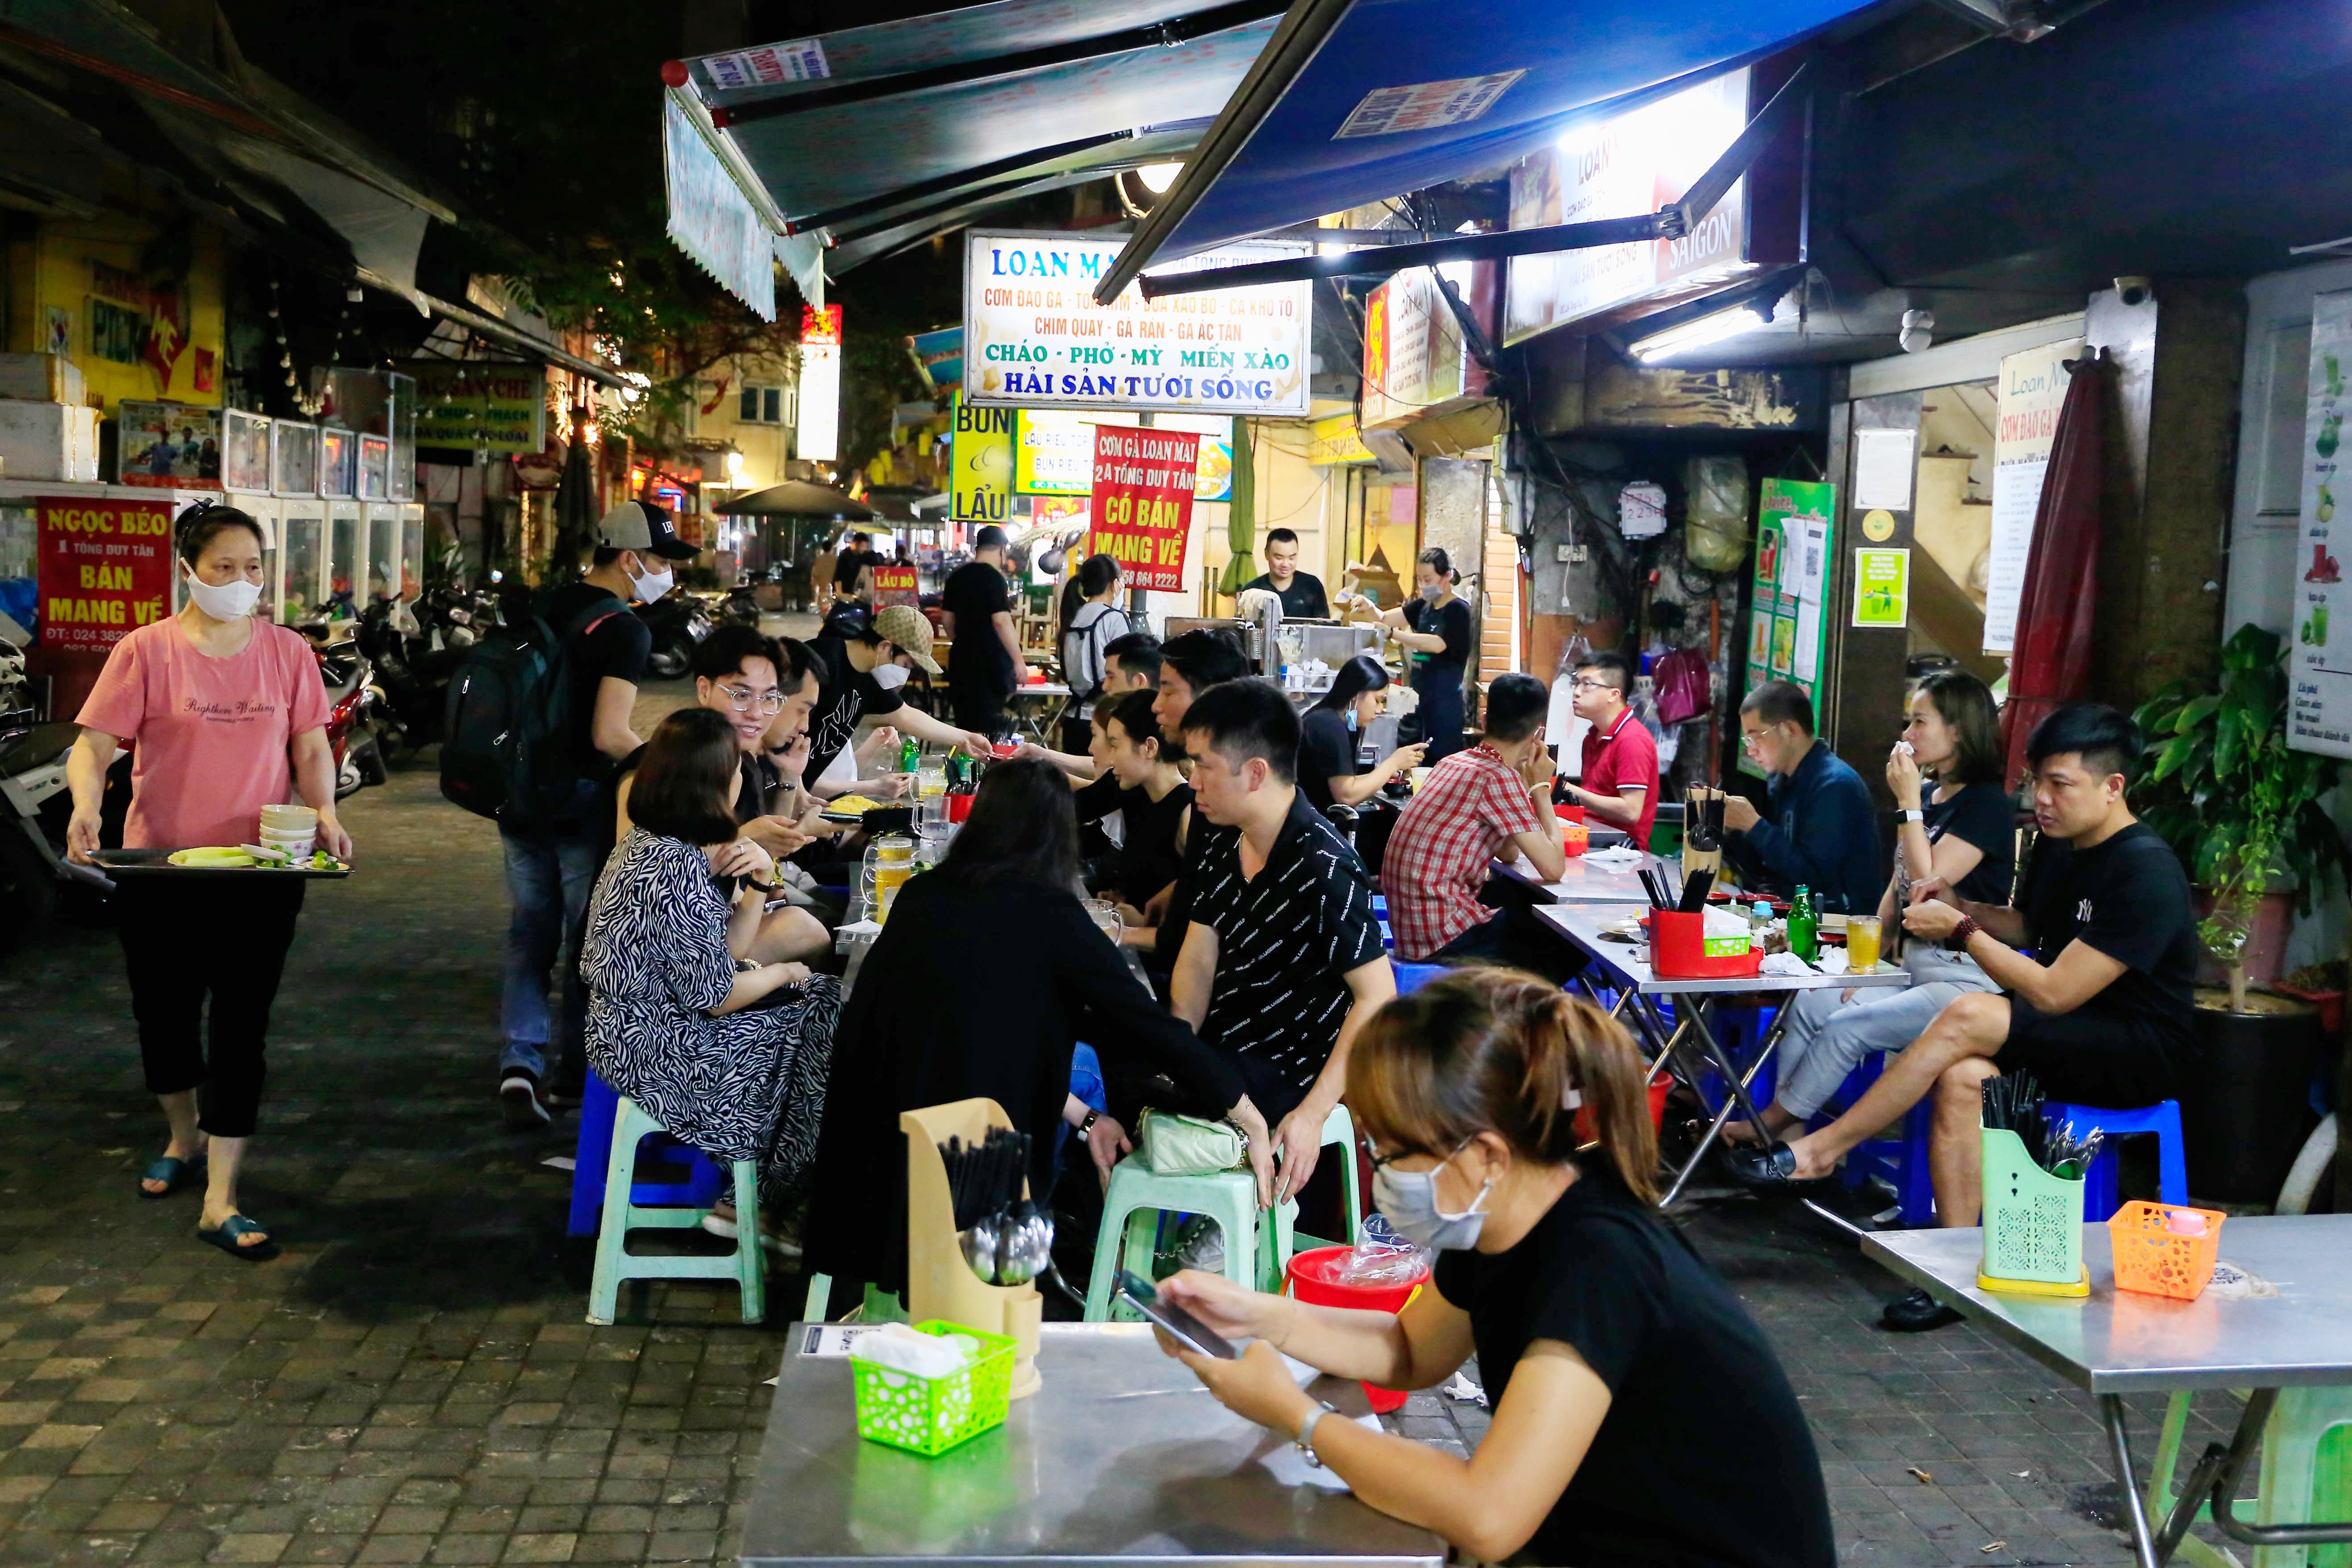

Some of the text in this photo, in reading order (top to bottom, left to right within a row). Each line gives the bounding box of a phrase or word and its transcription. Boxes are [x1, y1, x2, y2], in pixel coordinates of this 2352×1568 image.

[992, 249, 1069, 276] LOAN
[1080, 253, 1116, 278] MA
[985, 288, 1012, 307] CƠM
[1250, 299, 1274, 316] KHO
[1279, 295, 1292, 321] TỘ
[1035, 316, 1067, 335] CHIM
[1072, 319, 1103, 338] QUAY
[1117, 316, 1132, 338] GÀ
[1140, 317, 1165, 339] RÁN
[1178, 319, 1193, 340] GÀ
[1198, 319, 1214, 341] ÁC
[986, 339, 1289, 370] CHÁO PHỞ MỲ MIẾN XÀO
[1004, 366, 1273, 400] HẢI SẢN TƯƠI SỐNG
[2011, 370, 2044, 396] Loan
[1099, 433, 1196, 463] CƠM GÀ LOAN MAI
[1114, 461, 1144, 485] TỐNG
[1146, 469, 1170, 488] DUY
[1173, 468, 1195, 490] TÂN
[957, 484, 1005, 520] LẨU
[1106, 492, 1180, 529] CÓ BÁN
[47, 506, 167, 539] NGỌC BÉO
[106, 544, 129, 556] DUY
[133, 544, 154, 557] TÂN
[1094, 530, 1184, 566] MANG VỀ
[80, 561, 132, 590] BÁN
[1121, 570, 1178, 588] 58 864 2222
[49, 598, 125, 624] MANG
[74, 629, 96, 641] 024
[1318, 1013, 1328, 1023] KARL
[1327, 990, 1345, 1015] LAGERFELD
